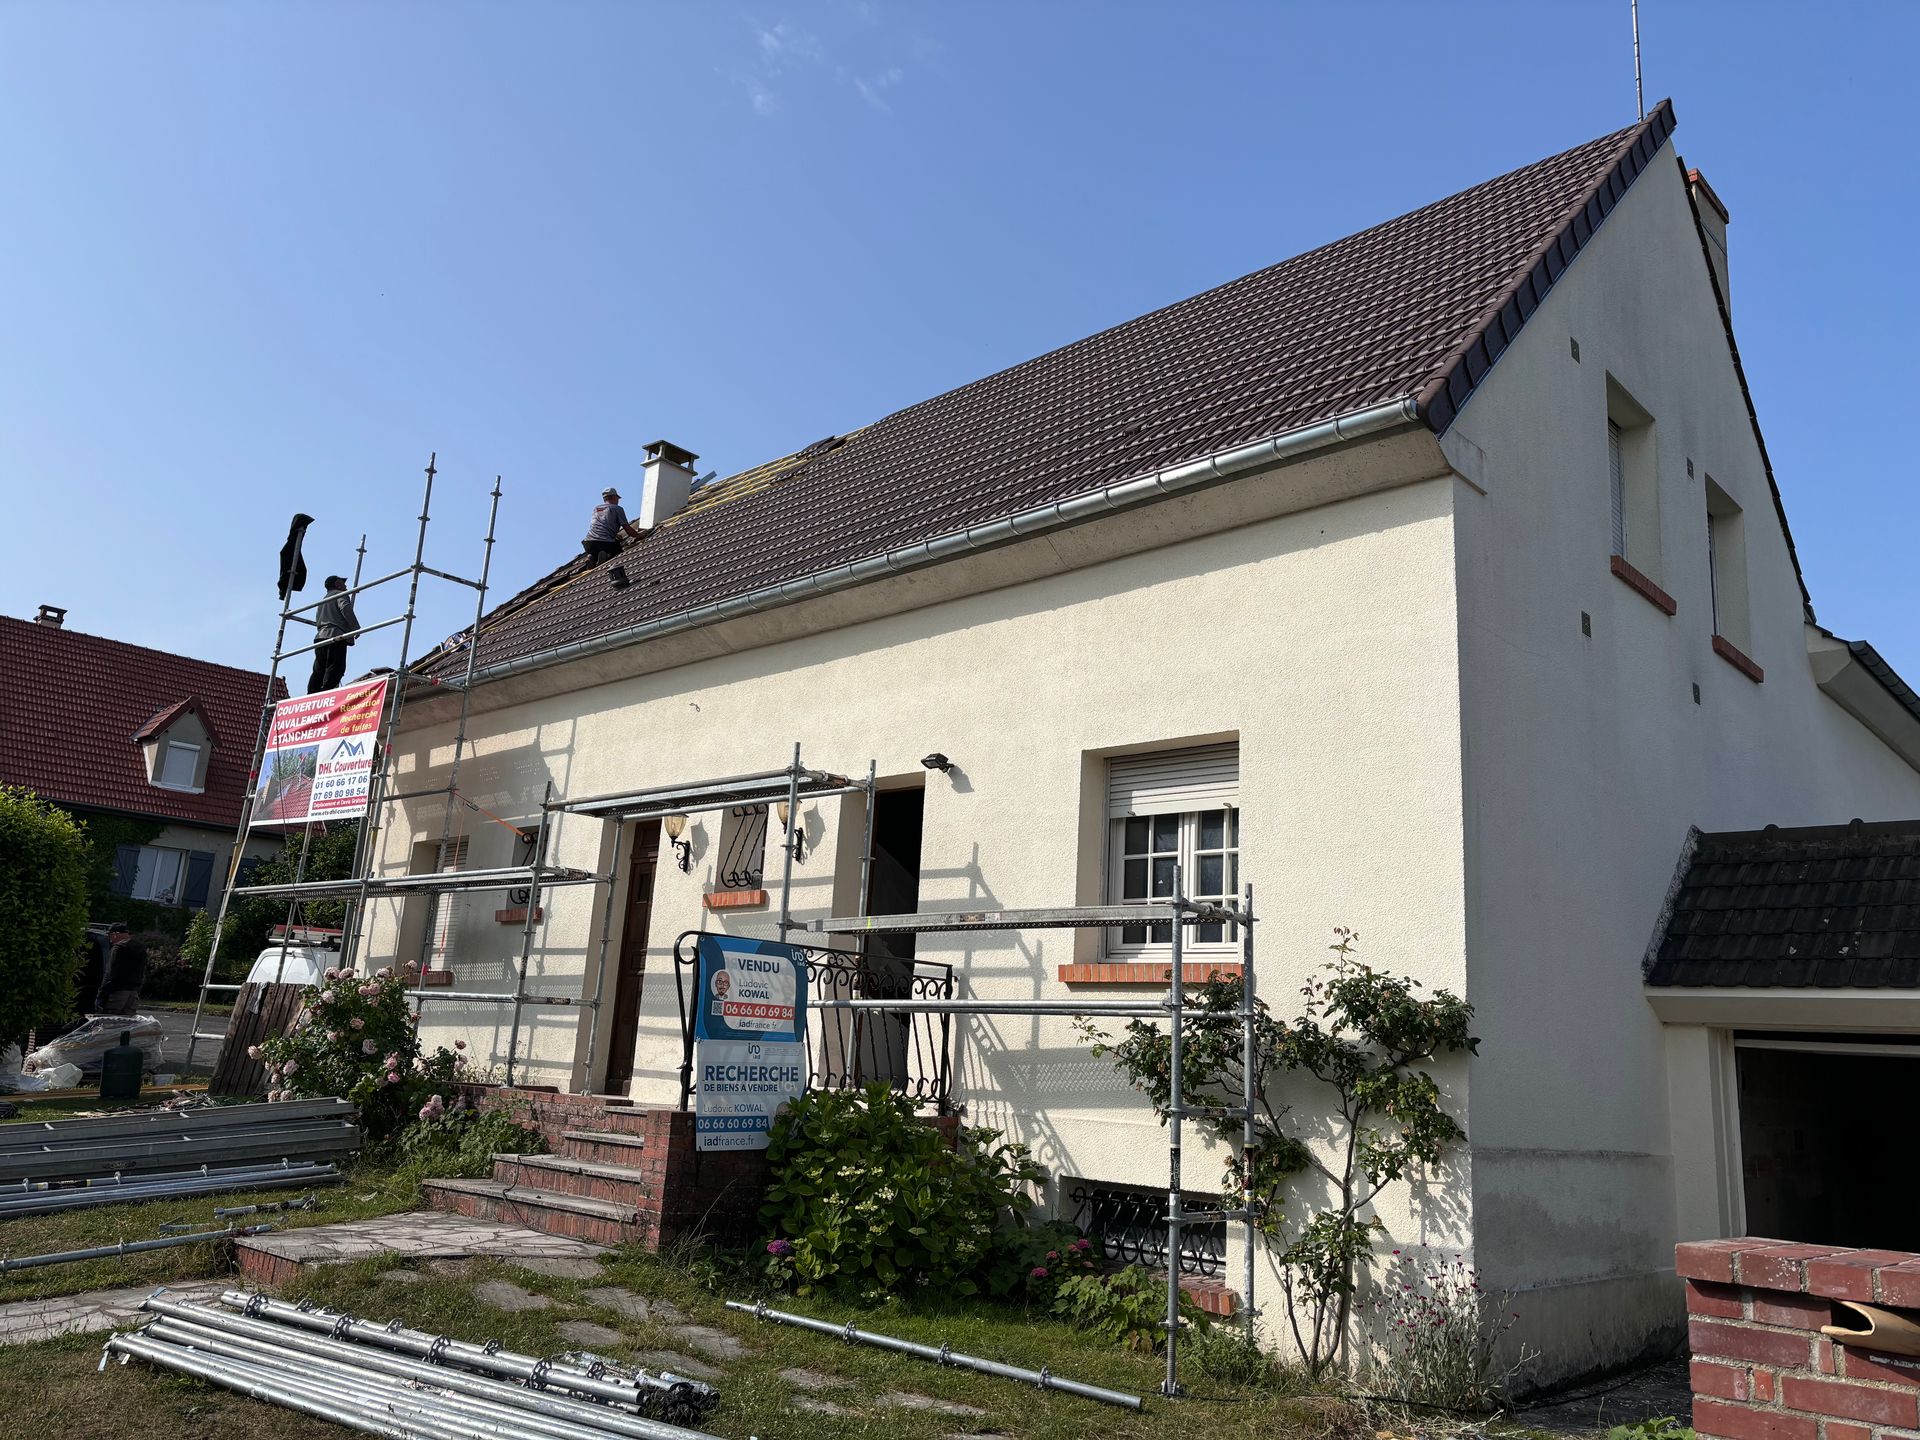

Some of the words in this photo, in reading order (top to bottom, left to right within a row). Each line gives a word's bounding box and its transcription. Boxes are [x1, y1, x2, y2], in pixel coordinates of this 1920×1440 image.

[277, 696, 336, 716] COUVERTURE
[274, 711, 331, 731] RAVALEMENT
[340, 710, 378, 723] Recherche
[352, 722, 372, 732] fuites
[318, 762, 332, 775] DHL
[334, 759, 372, 773] Couverture
[315, 781, 324, 789] 01
[326, 780, 334, 788] 60
[336, 778, 346, 786] 66
[348, 776, 356, 784] 17
[358, 776, 368, 784] 06
[324, 791, 332, 799] 69
[346, 788, 354, 796] 98
[356, 787, 366, 795] 54
[738, 958, 780, 974] VENDU
[738, 978, 768, 989] Ludovic
[738, 989, 770, 1000] KOWAL
[725, 1004, 738, 1016] 06
[740, 1005, 752, 1016] 66
[754, 1006, 766, 1016] 60
[768, 1007, 780, 1017] 69
[782, 1008, 793, 1018] 84
[739, 1020, 777, 1030] iadfrance.fr
[705, 1065, 799, 1082] RECHERCHE
[748, 1084, 778, 1092] VENDRE
[704, 1104, 732, 1112] Ludovic
[734, 1104, 764, 1112] KOWAL
[698, 1119, 710, 1128] 06
[712, 1119, 724, 1128] 66
[727, 1118, 740, 1128] 60
[742, 1118, 754, 1128] 69
[756, 1118, 768, 1128] 84
[704, 1134, 754, 1146] iadfrance.fr
